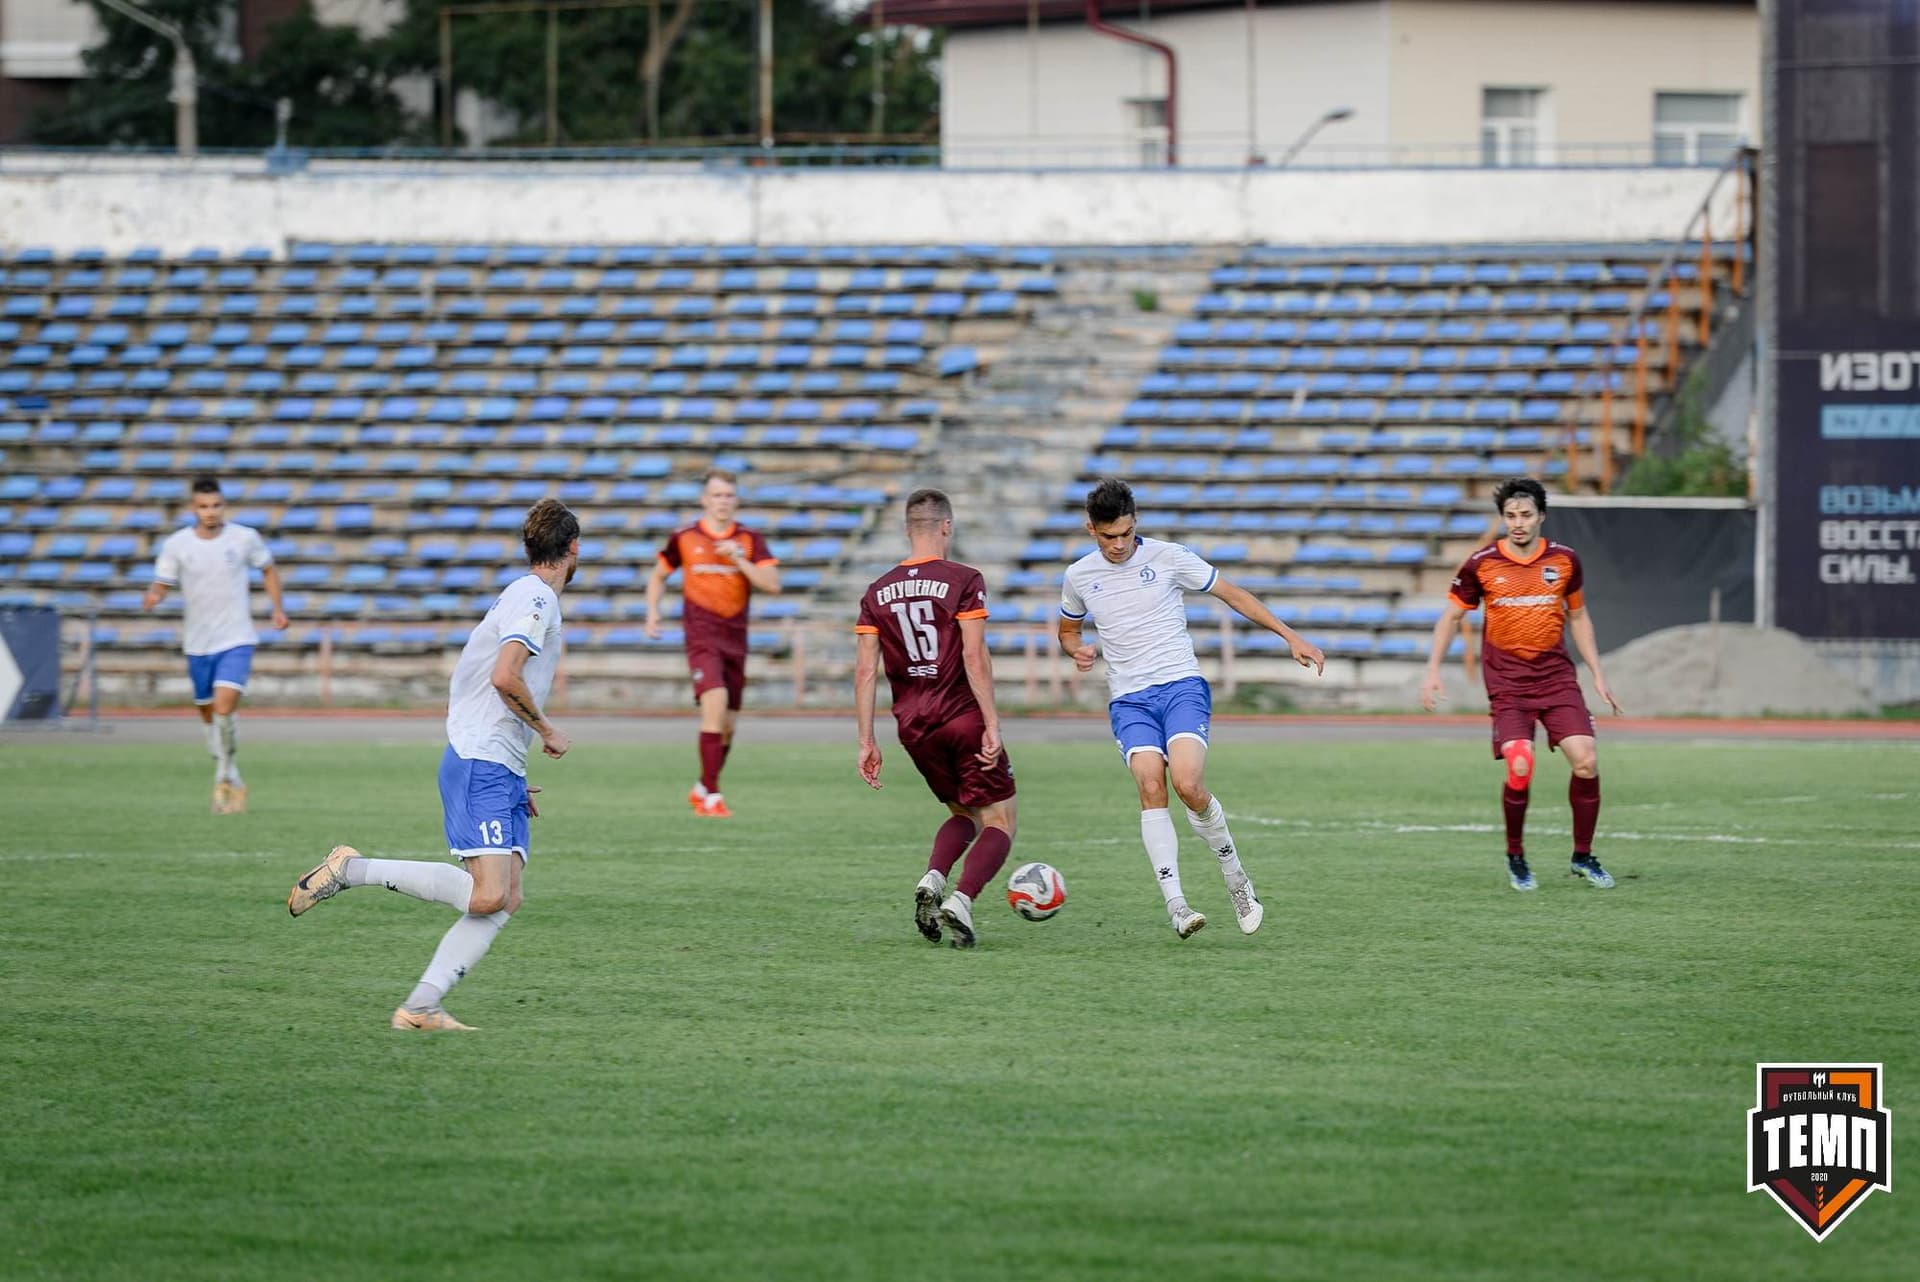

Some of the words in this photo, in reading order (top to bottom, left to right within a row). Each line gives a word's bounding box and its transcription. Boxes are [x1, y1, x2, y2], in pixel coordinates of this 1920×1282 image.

[1820, 520, 1920, 550] ВОССТ
[876, 579, 950, 606] ЕВТУШЕНКО
[890, 600, 938, 662] 15
[479, 820, 503, 845] 13
